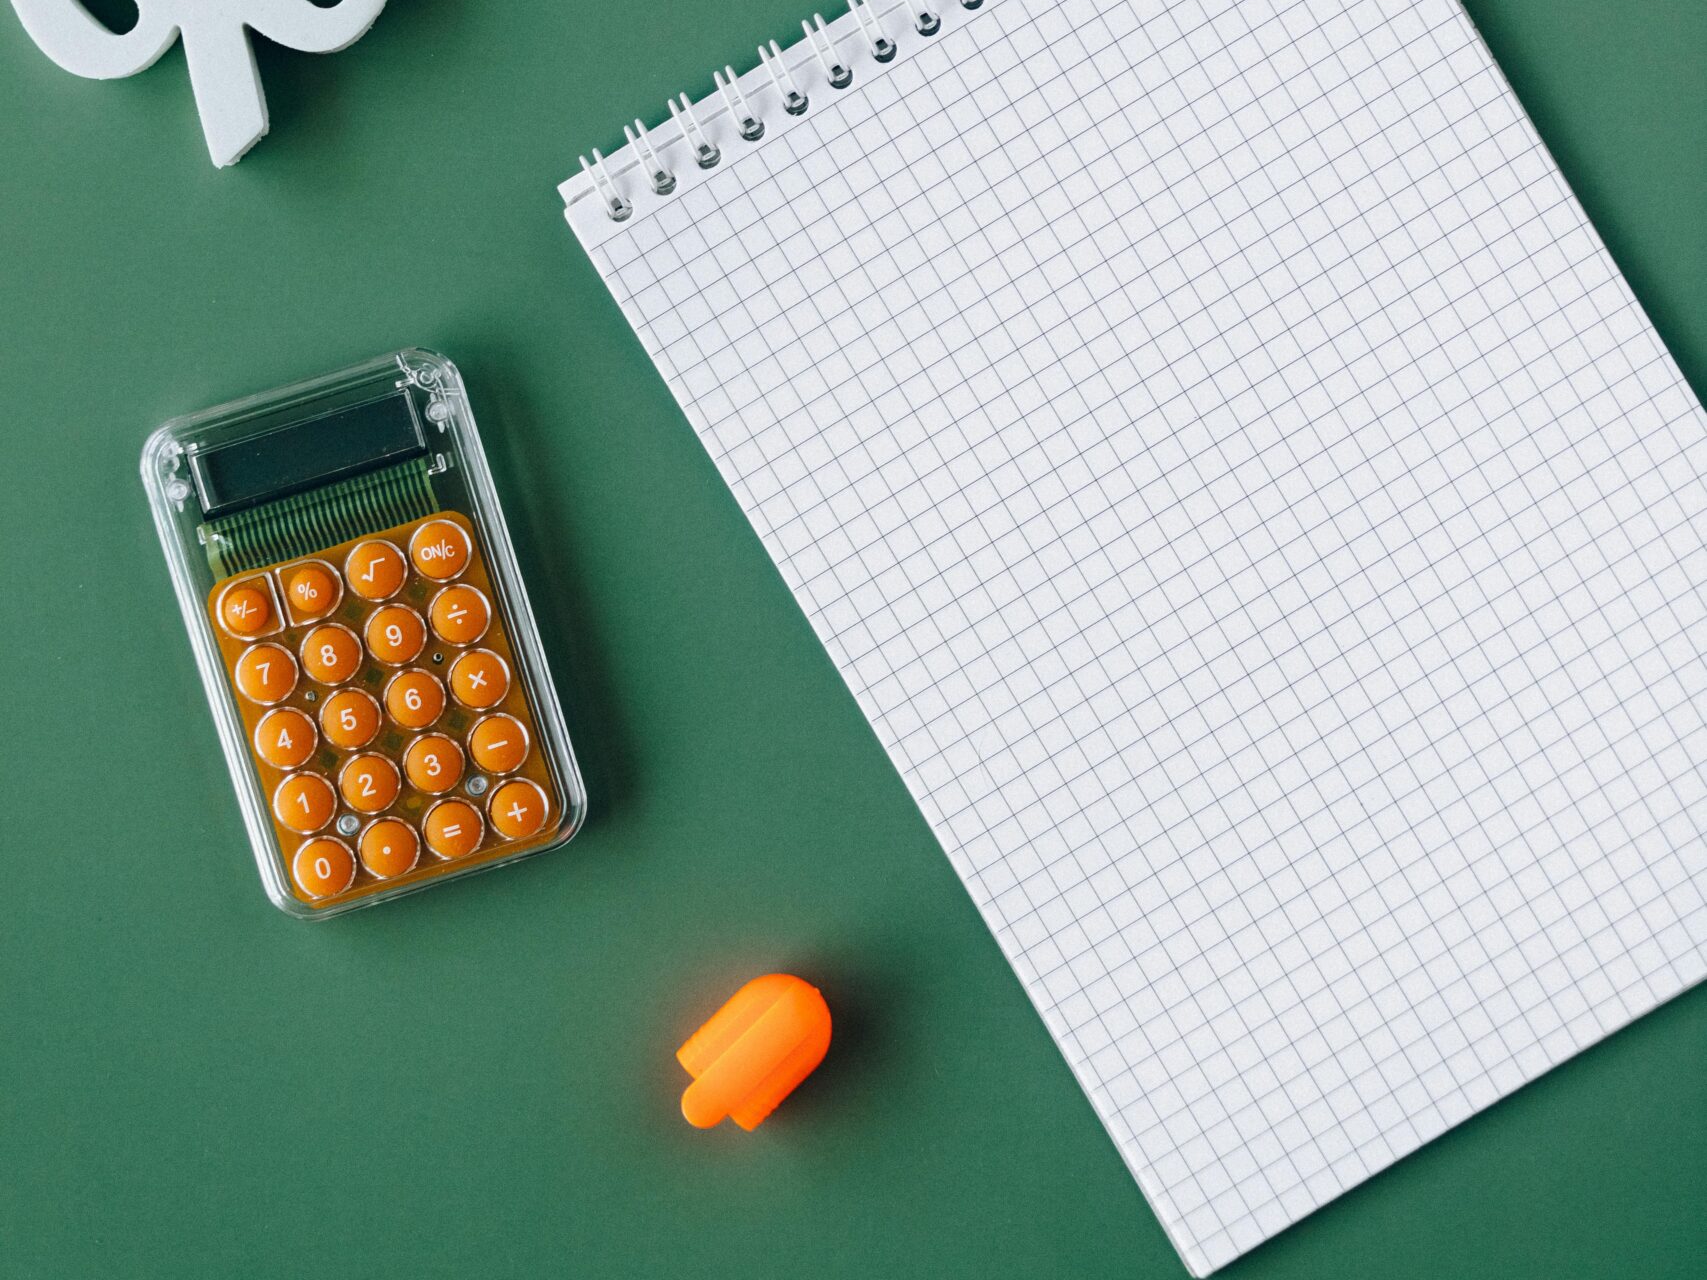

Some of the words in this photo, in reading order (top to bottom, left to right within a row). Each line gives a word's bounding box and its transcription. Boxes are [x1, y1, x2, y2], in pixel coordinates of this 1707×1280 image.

[421, 540, 454, 560] ON/C
[386, 625, 402, 646] 9
[321, 645, 336, 666] 8
[256, 663, 269, 684] 7
[405, 689, 421, 710] 6
[341, 709, 356, 730] 5
[278, 729, 292, 748] 4
[424, 755, 440, 775] 3
[359, 774, 375, 796] 2
[298, 793, 309, 812] 1
[315, 858, 330, 878] 0
